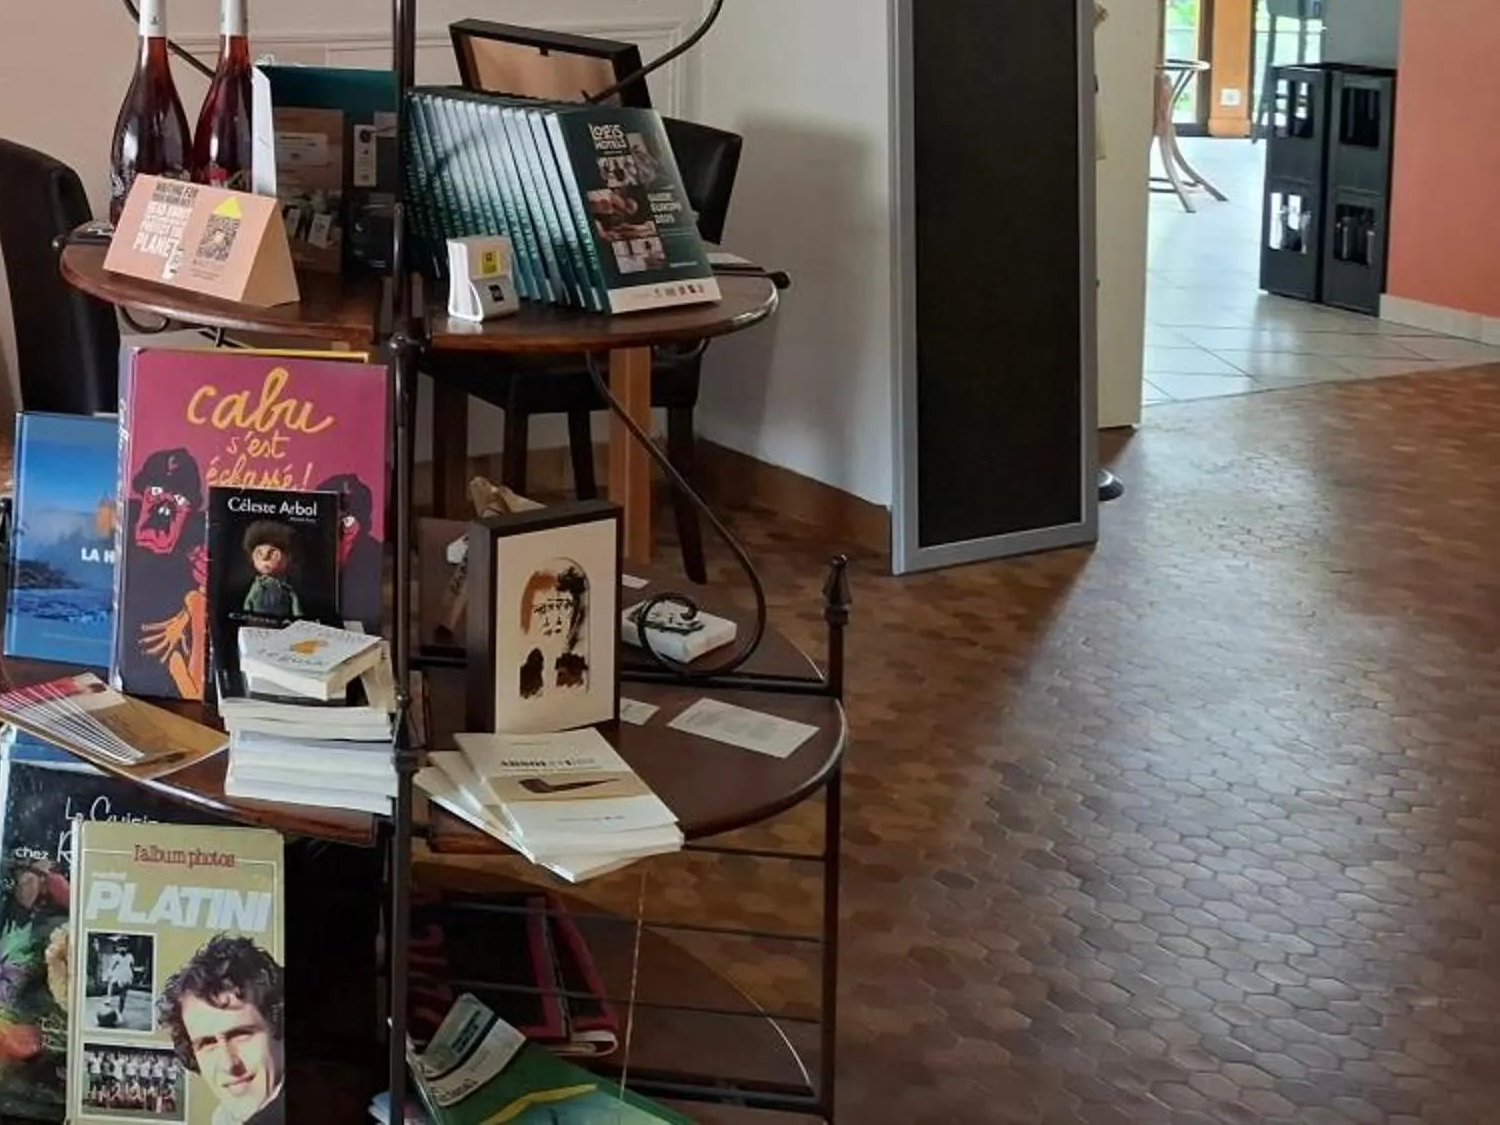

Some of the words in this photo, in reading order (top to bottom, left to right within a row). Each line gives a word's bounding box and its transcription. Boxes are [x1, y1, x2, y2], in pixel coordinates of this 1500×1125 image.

[186, 366, 335, 434] cabu
[225, 429, 292, 458] s'est
[227, 496, 277, 515] Céleste
[279, 499, 318, 517] Arbol
[81, 547, 100, 563] LA
[14, 845, 49, 860] chez
[188, 850, 235, 869] photos
[85, 879, 272, 933] PLATINI
